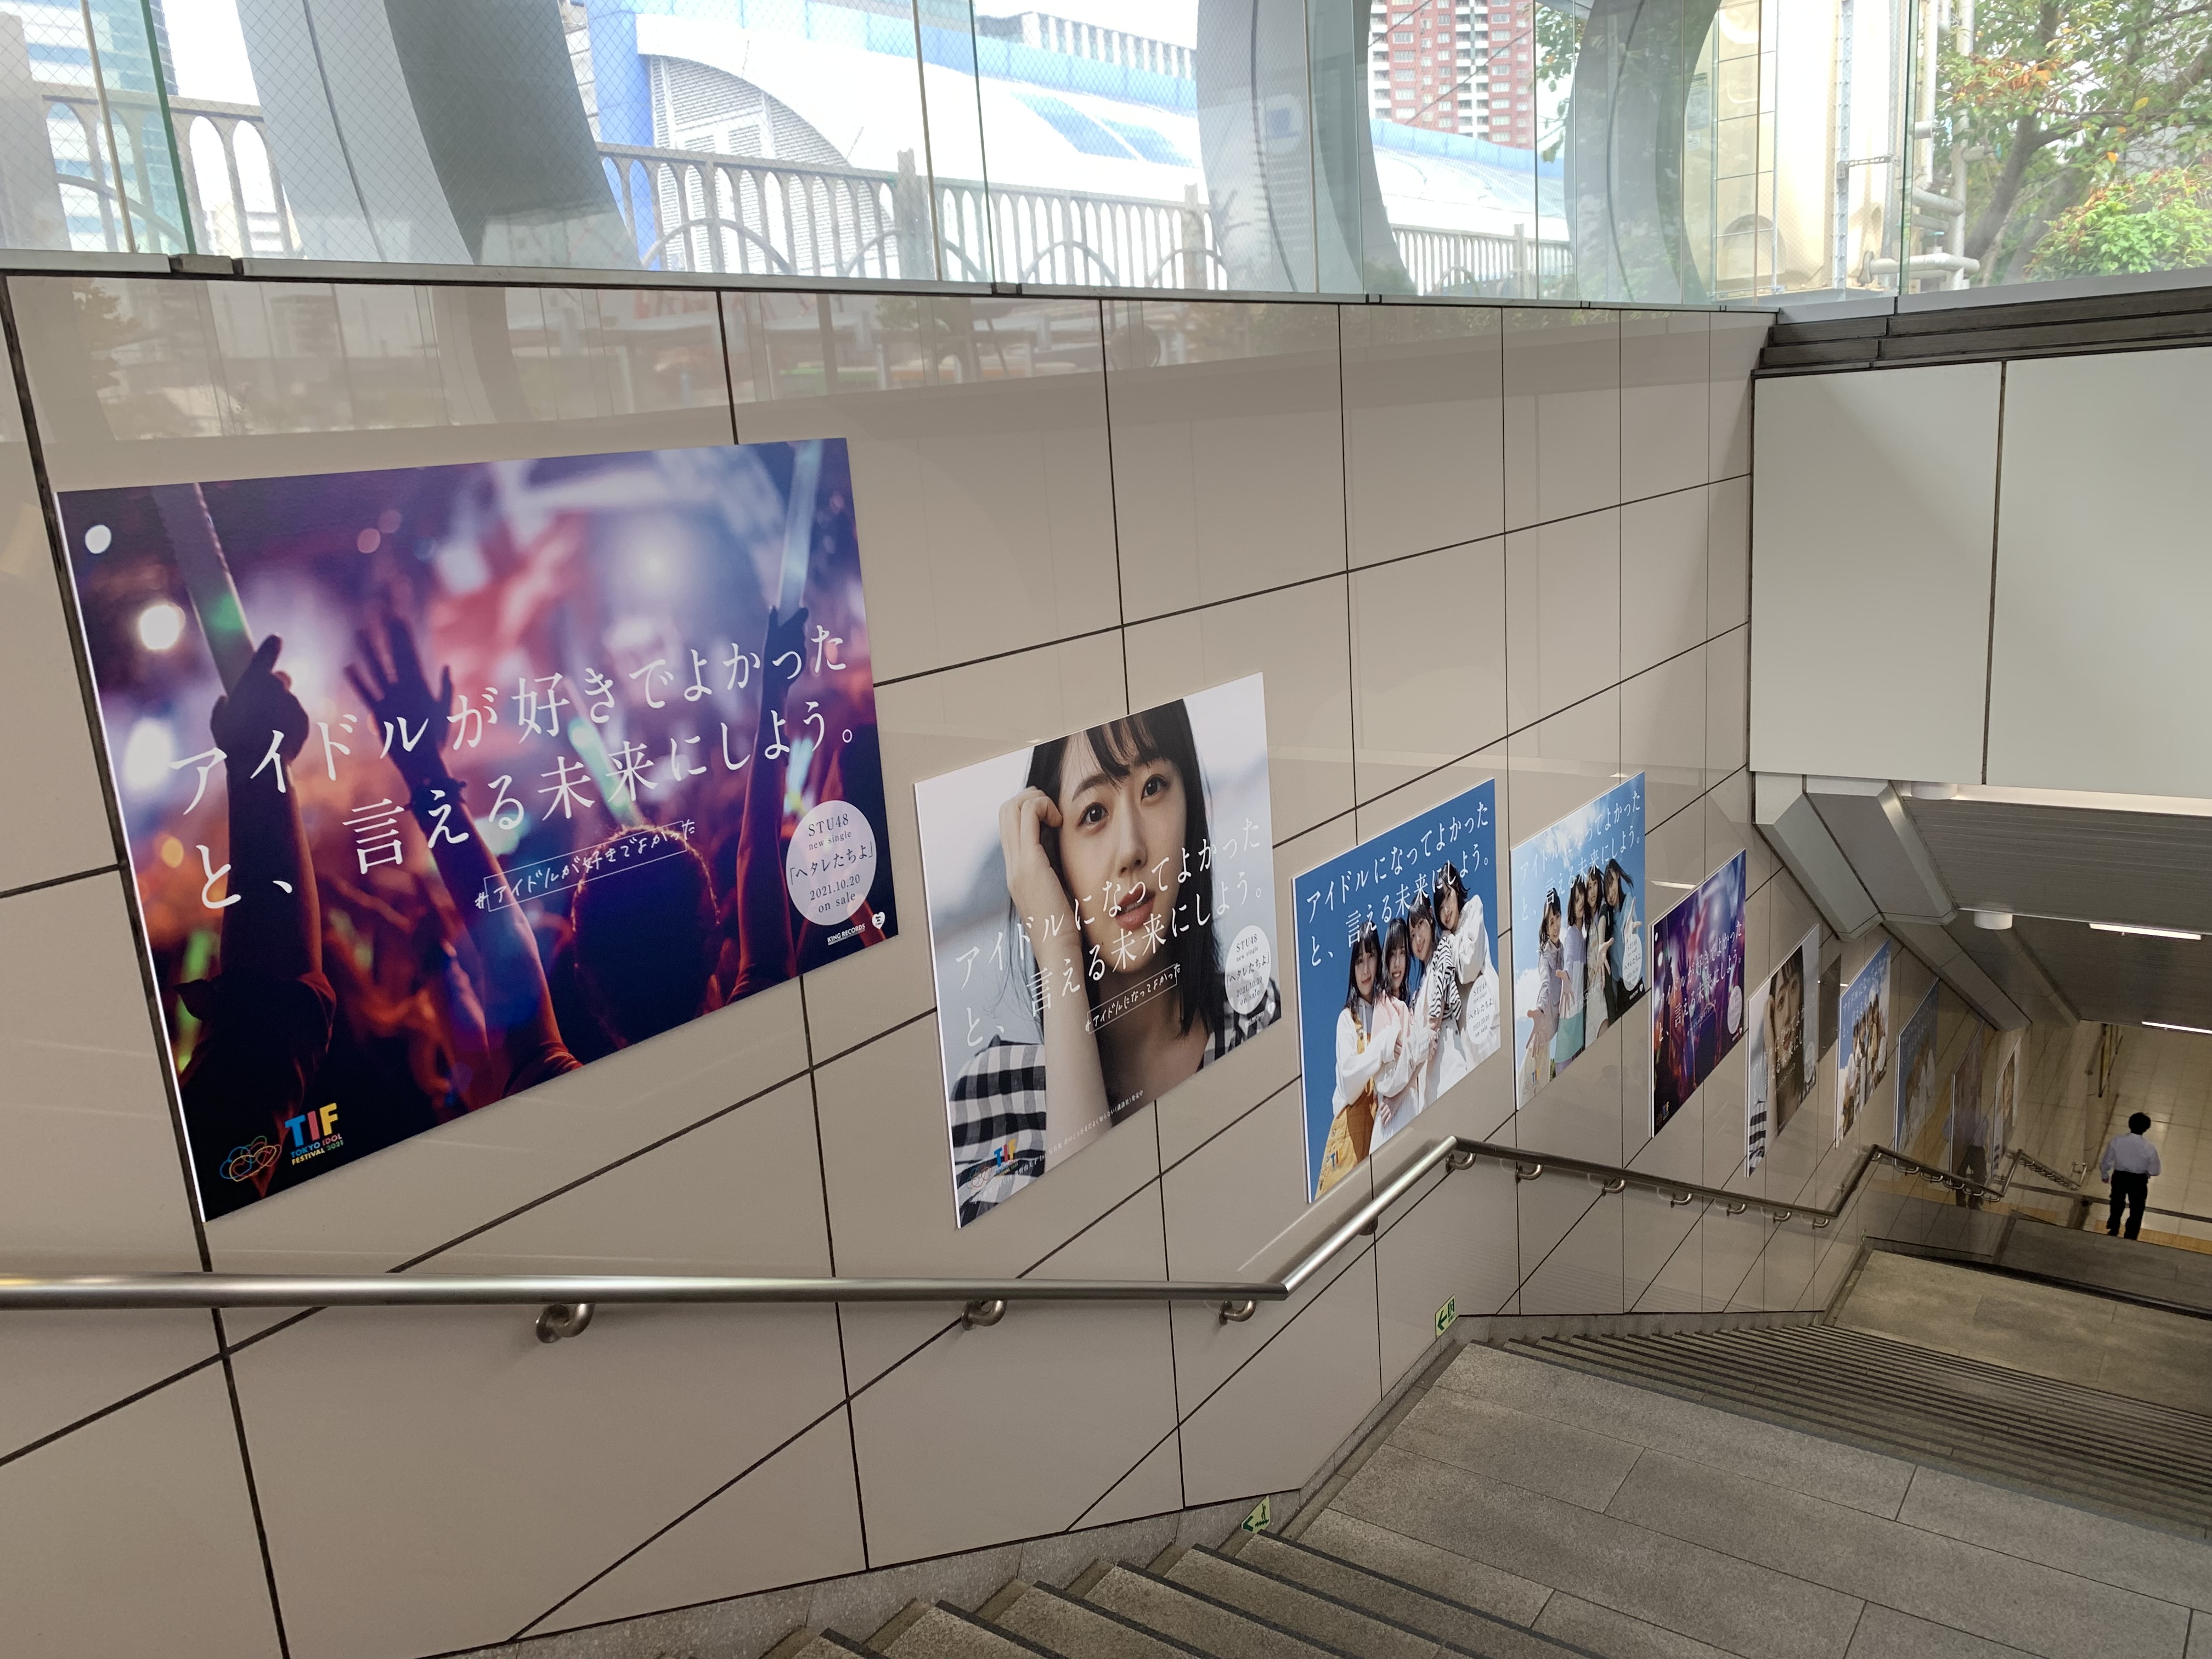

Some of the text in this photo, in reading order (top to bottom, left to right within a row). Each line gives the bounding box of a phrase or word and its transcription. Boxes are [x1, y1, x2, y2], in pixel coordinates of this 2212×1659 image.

[170, 624, 847, 815] アイドルが好きでよかった
[196, 701, 853, 909] と、言える未来にしよう。
[808, 813, 849, 837] STU48
[809, 831, 851, 851] new single
[475, 819, 695, 909] #アイドルが好きでよかった
[790, 841, 874, 885] 「ヘタレたちよ」
[1306, 801, 1488, 923] アイドルになってよかった
[810, 874, 861, 901] 2021.10.20
[818, 893, 856, 913] on sale
[956, 817, 1260, 990] アイドルになってよかった
[1311, 843, 1489, 967] と、言える未来にしよう。
[827, 923, 866, 943] KING RECORDS
[1235, 933, 1257, 953] STU48
[966, 871, 1262, 1047] と、言える未来にしよう。
[285, 1102, 338, 1147] TIF
[290, 1133, 342, 1159] TOKYO IDOL
[291, 1139, 344, 1165] FESTIVAL 2021
[994, 1138, 1017, 1168] TIF
